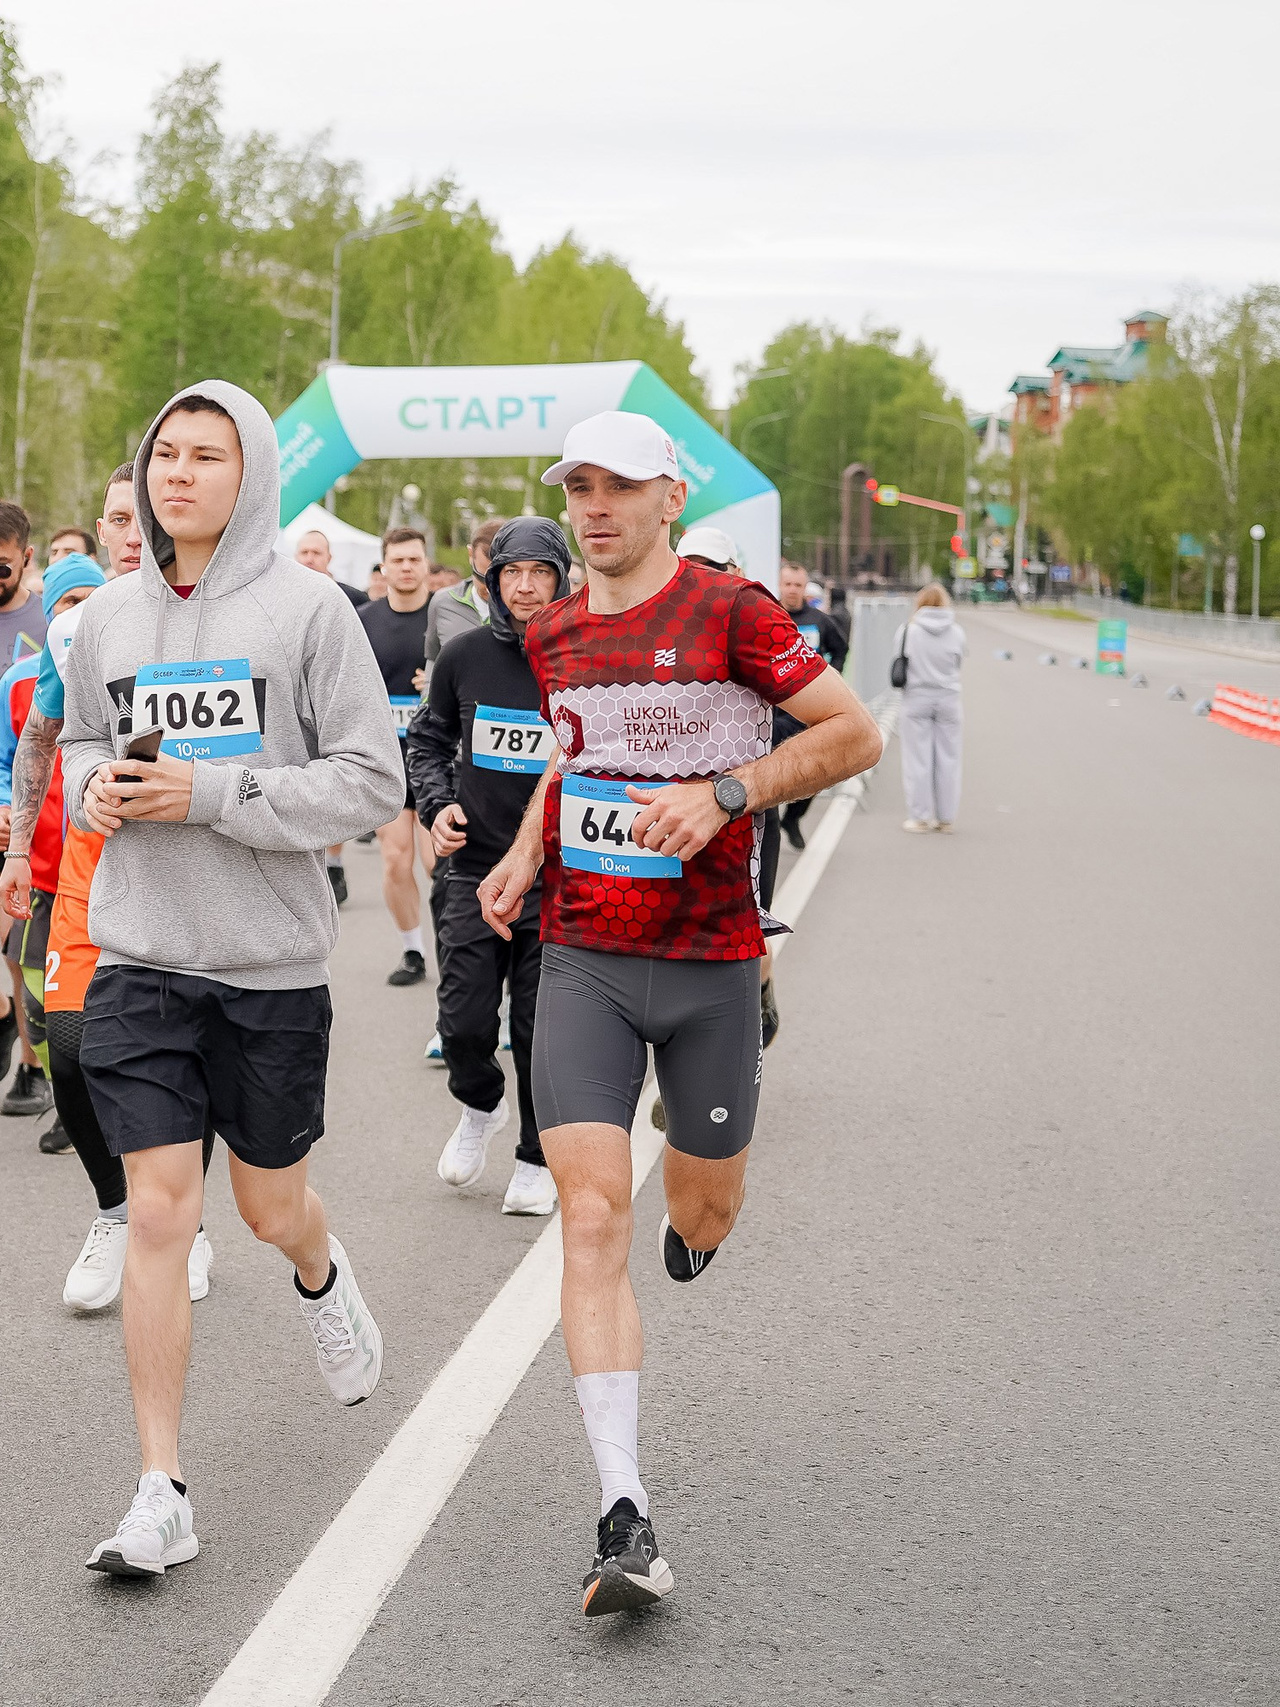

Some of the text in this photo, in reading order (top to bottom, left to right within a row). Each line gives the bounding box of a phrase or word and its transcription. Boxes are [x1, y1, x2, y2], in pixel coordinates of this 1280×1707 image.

[398, 395, 557, 430] СТАРТ
[144, 689, 244, 730] 1062
[624, 706, 680, 720] LUKOIL
[490, 727, 542, 754] 787
[624, 720, 710, 737] TRIATHLON
[626, 738, 670, 752] TEAM
[238, 769, 250, 805] adidas
